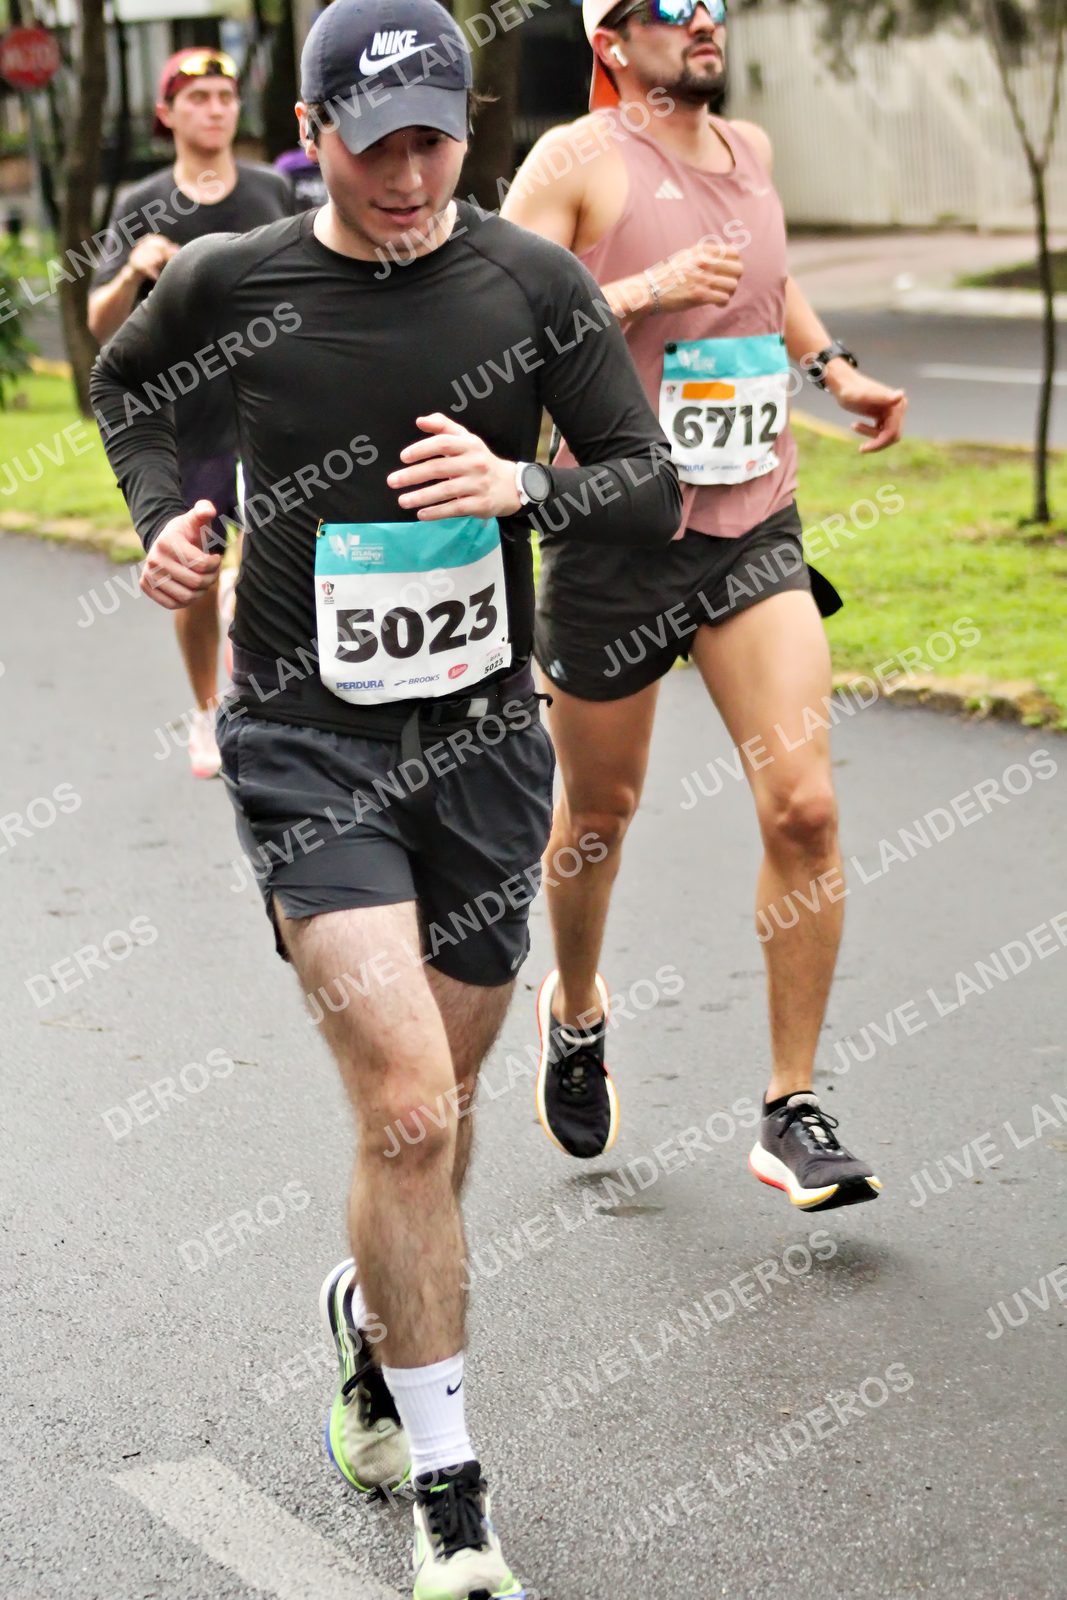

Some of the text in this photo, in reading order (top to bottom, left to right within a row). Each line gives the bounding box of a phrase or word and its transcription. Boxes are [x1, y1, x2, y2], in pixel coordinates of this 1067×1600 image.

[371, 30, 418, 55] NIKE
[672, 401, 778, 449] 6712
[334, 583, 498, 664] 5023
[336, 674, 440, 690] PERDURA BROOKS
